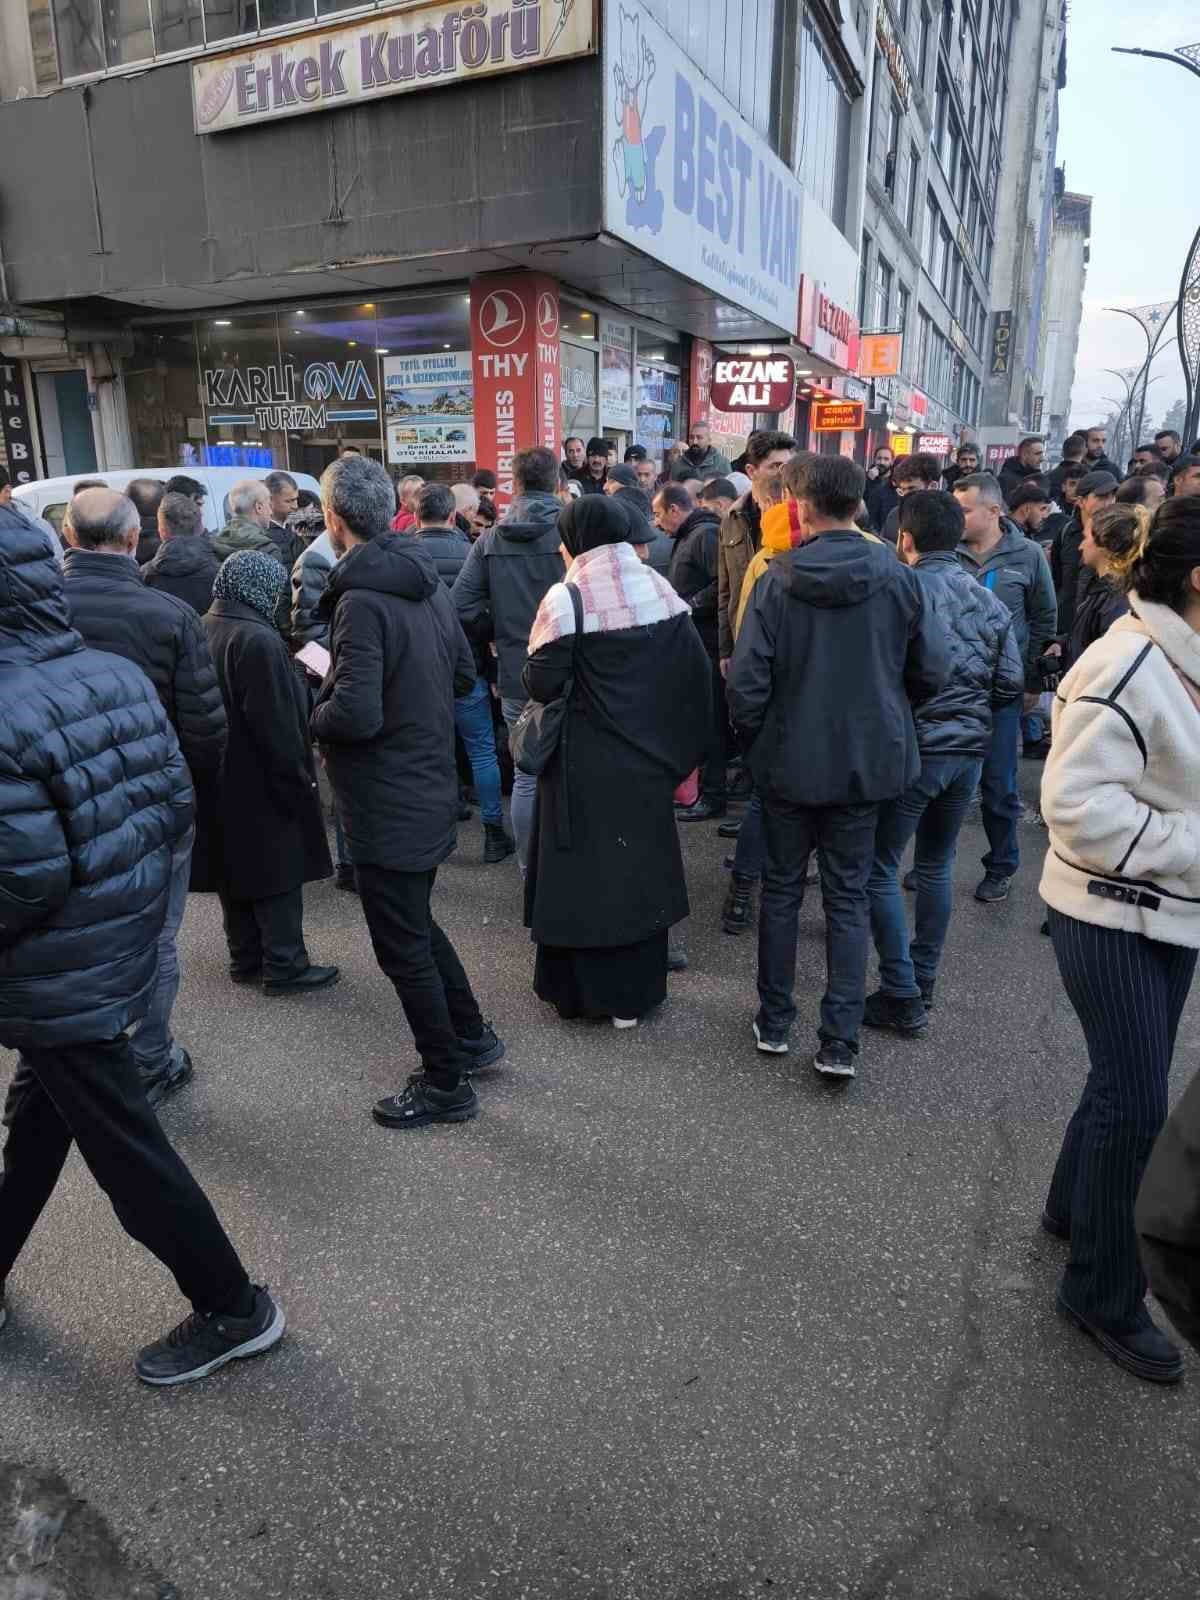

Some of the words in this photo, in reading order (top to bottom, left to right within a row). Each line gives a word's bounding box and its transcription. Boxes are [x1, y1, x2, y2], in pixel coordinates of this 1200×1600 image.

[235, 40, 348, 116] Erkek
[360, 0, 540, 89] Kuaförü
[673, 71, 752, 256] BEST
[758, 159, 800, 290] VAN
[478, 352, 529, 379] THY
[538, 343, 559, 365] THY
[872, 344, 889, 368] E
[205, 365, 296, 406] KARLI
[303, 360, 377, 400] OVA
[716, 361, 789, 383] ECZANE
[496, 390, 514, 496] AIRLINES
[989, 447, 1015, 459] BİM
